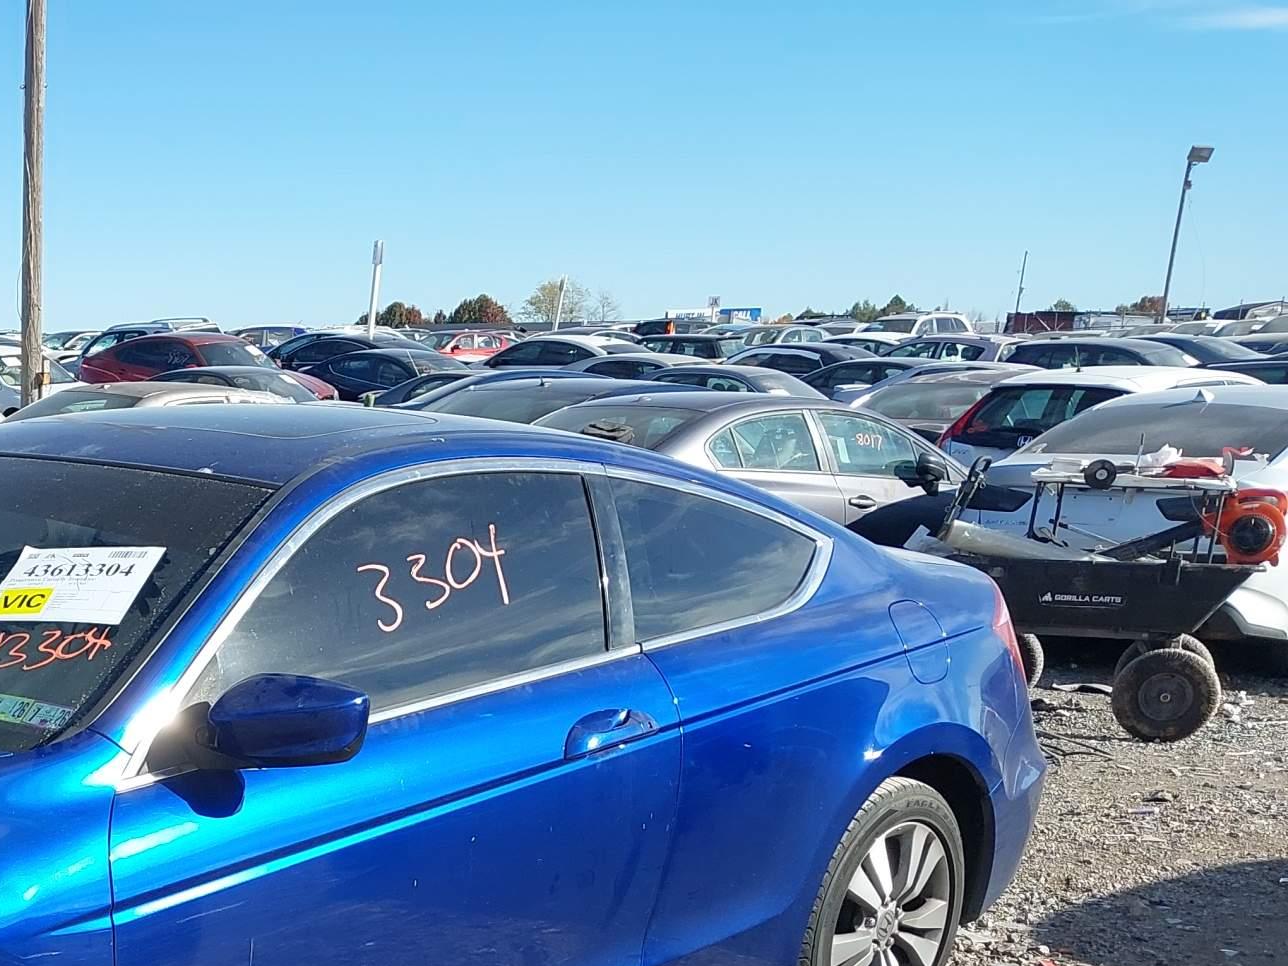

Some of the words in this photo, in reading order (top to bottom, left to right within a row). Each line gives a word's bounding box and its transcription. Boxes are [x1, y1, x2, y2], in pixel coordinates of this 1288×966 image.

[23, 563, 135, 577] 43613304
[357, 523, 505, 633] 3304
[3, 593, 46, 609] VIC
[1054, 594, 1090, 602] GORILLA
[1092, 595, 1122, 603] CARTS
